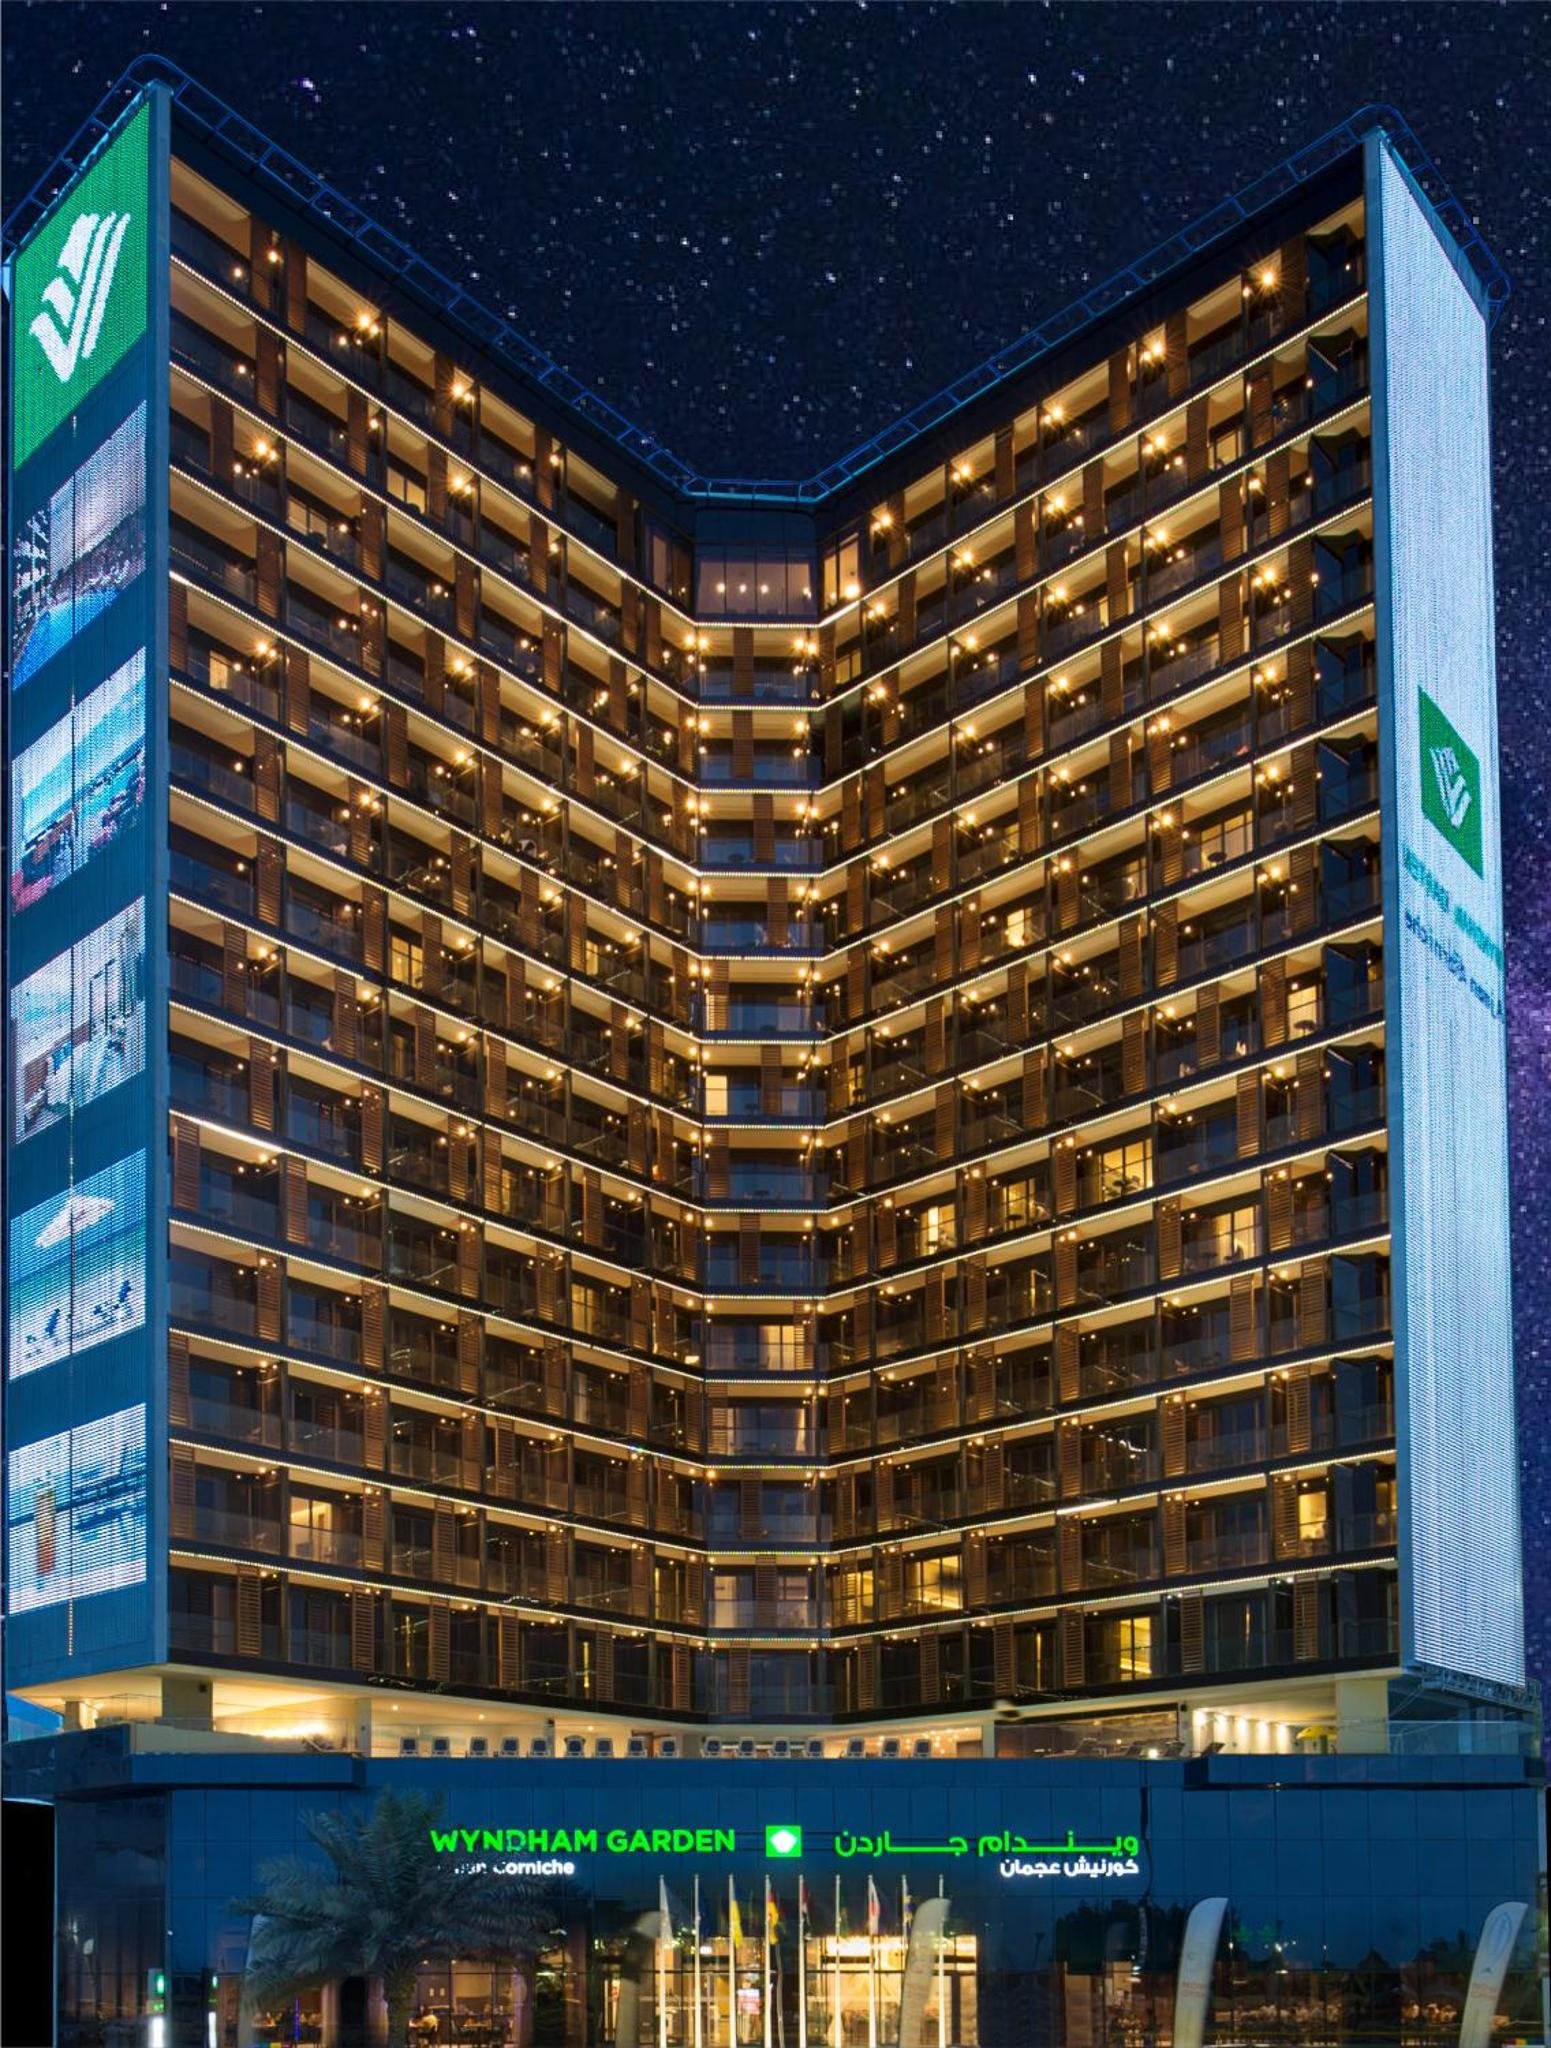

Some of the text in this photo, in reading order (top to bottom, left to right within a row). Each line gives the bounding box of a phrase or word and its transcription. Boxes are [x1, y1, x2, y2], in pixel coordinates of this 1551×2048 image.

[430, 1828, 736, 1853] WYNDHAM GARDEN
[834, 1829, 1140, 1858] ويندام جاردن
[999, 1855, 1140, 1879] كورنيش عجمان
